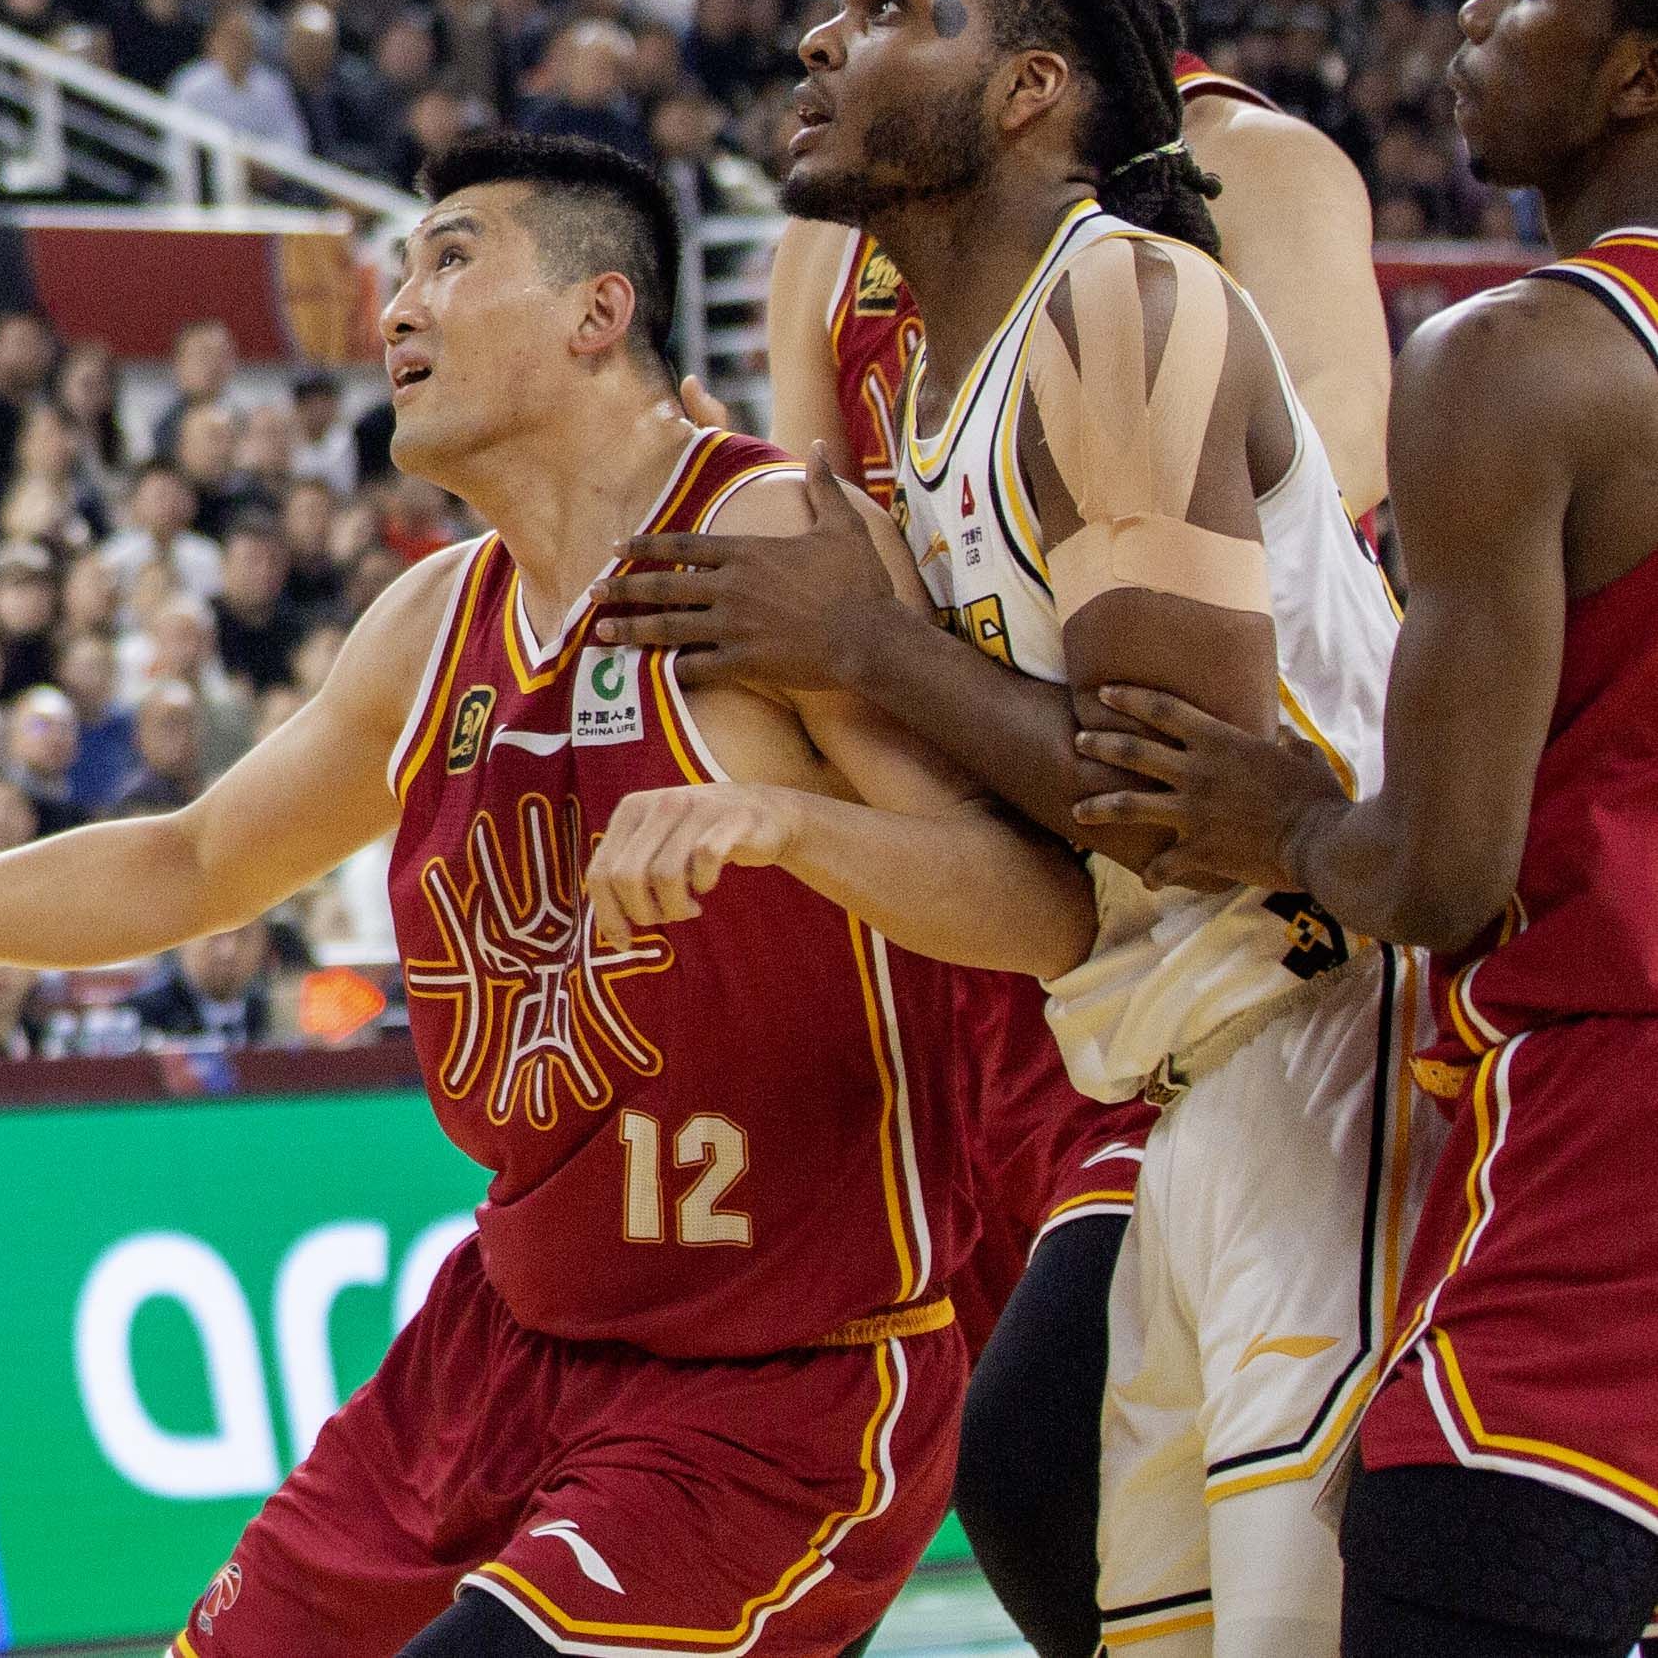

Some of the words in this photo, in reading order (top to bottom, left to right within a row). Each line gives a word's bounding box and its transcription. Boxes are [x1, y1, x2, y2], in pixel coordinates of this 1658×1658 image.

[577, 726, 613, 737] CHINA
[616, 722, 636, 734] LIFE
[620, 1107, 755, 1248] 12
